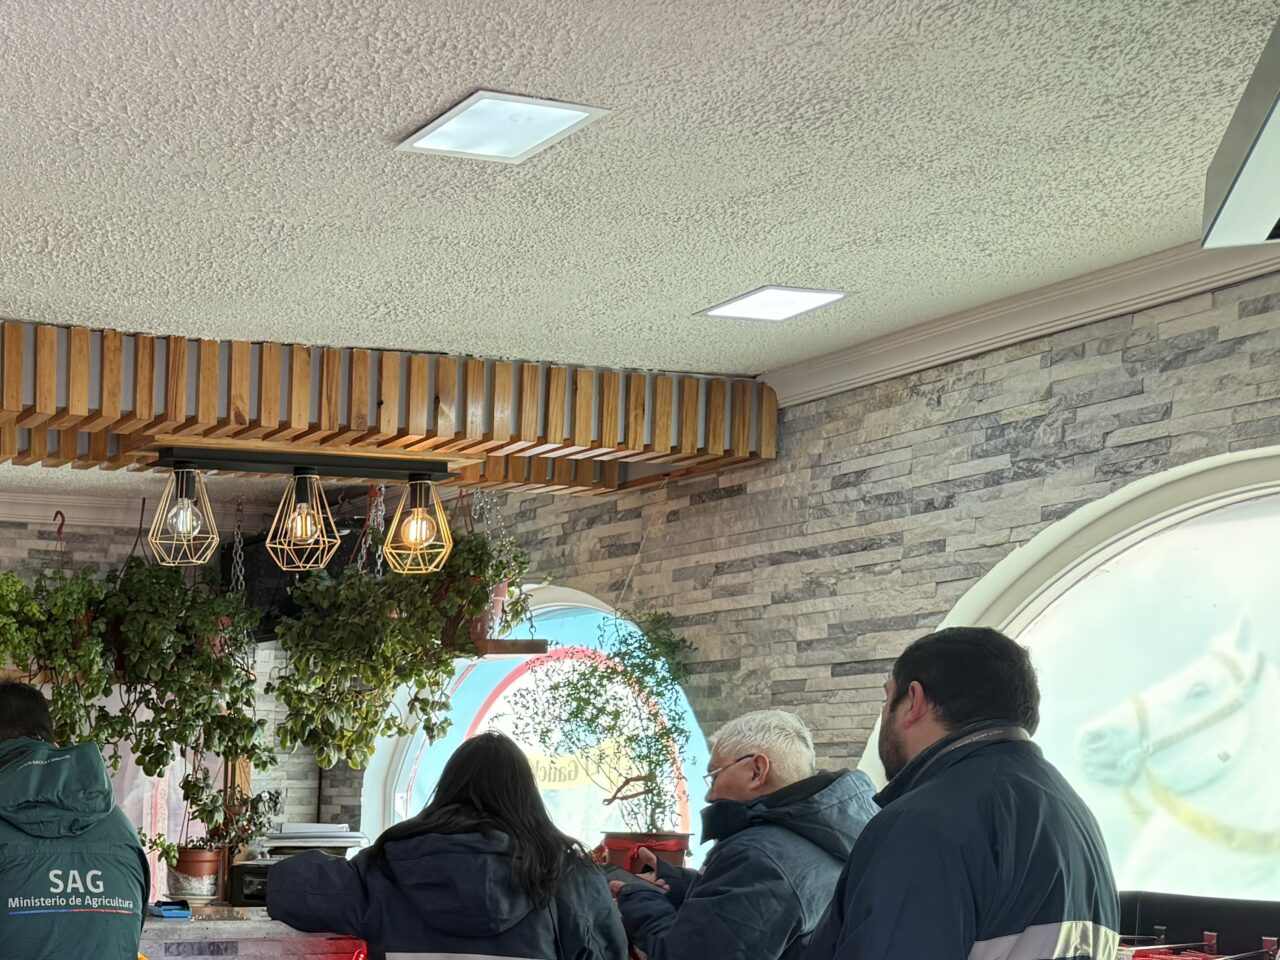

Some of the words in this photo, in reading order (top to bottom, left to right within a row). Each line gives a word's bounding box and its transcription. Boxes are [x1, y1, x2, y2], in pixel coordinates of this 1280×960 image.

[49, 869, 105, 894] SAG
[8, 896, 66, 909] Ministerio
[69, 895, 82, 906] de
[85, 896, 134, 909] Agricultura
